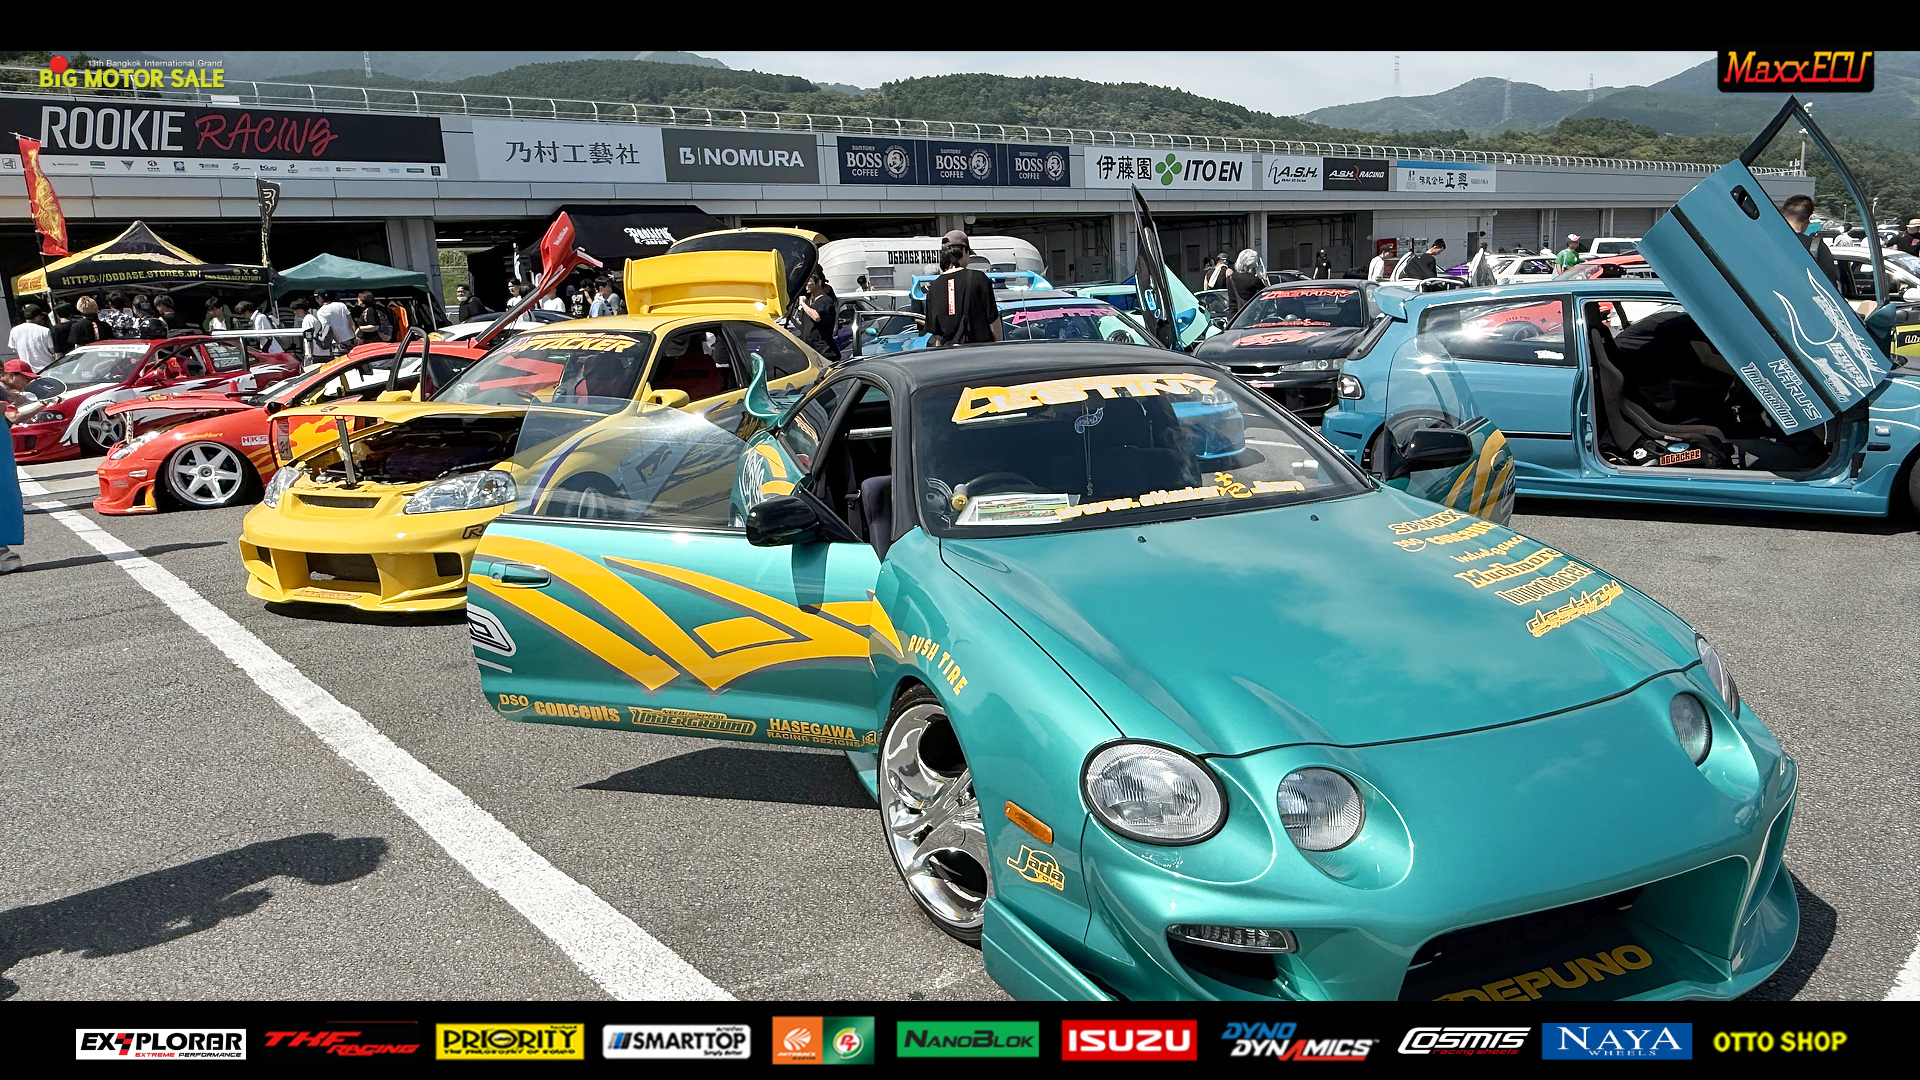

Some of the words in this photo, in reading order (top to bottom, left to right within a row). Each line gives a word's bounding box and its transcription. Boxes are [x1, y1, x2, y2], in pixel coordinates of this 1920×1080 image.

[40, 106, 185, 151] ROOKIE
[195, 114, 339, 157] RACING
[505, 141, 641, 165] 乃村工藝社
[704, 148, 805, 168] NOMURA
[846, 152, 882, 167] BOSS
[935, 155, 968, 171] BOSS
[1014, 157, 1044, 171] BOSS
[852, 168, 879, 176] COFFEE
[940, 171, 964, 179] COFFEE
[1096, 154, 1153, 181] 伊藤園
[1184, 160, 1217, 182] ITO
[1219, 161, 1243, 182] EN
[952, 374, 1219, 423] DESTINY
[908, 634, 940, 661] RUSH
[938, 651, 968, 695] TIRE
[499, 694, 530, 707] DSO
[534, 701, 621, 722] concepts
[767, 731, 809, 742] RACING
[769, 718, 856, 739] HASEGAWA
[1007, 844, 1065, 883] Jada
